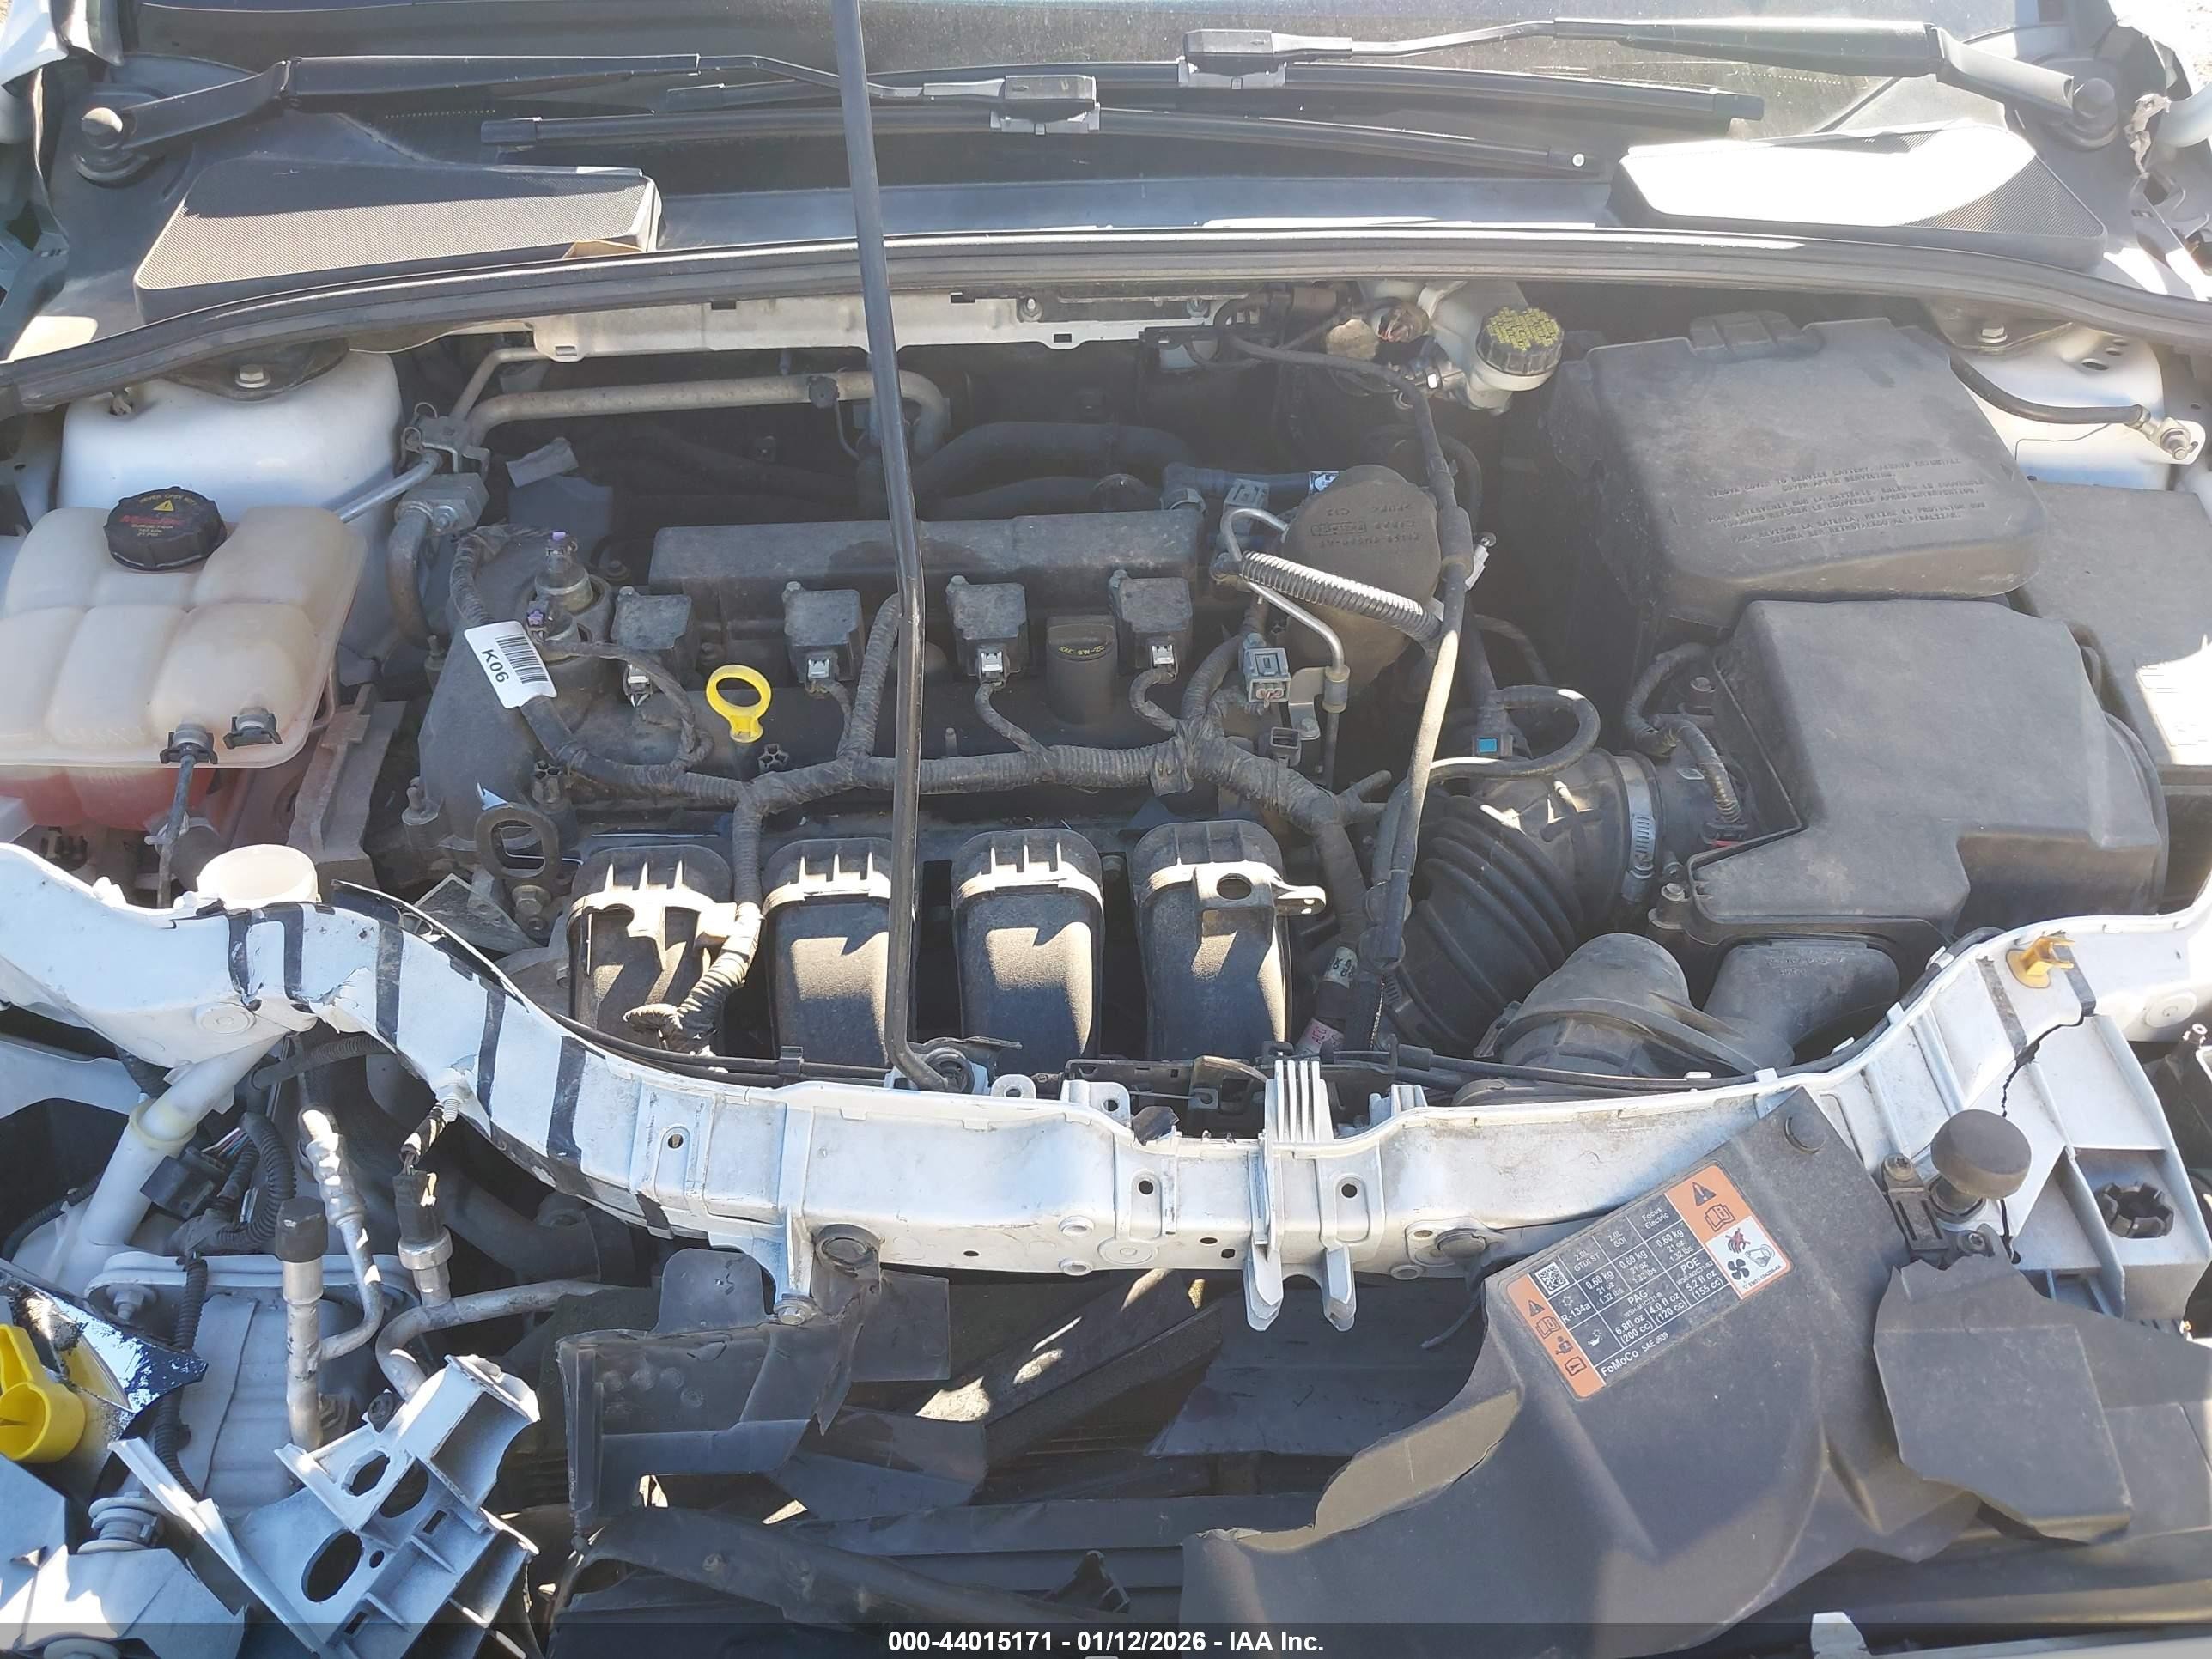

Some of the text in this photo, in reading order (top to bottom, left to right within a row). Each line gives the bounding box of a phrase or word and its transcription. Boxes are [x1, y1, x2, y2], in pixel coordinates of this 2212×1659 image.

[1059, 645, 1105, 655] SAE 5W-20
[481, 649, 509, 683] K06
[1641, 1207, 1662, 1221] Focus
[1644, 1212, 1670, 1230] Electric
[1607, 1230, 1623, 1243] 2.0L
[1613, 1237, 1628, 1248] GDI
[1656, 1228, 1685, 1249] 0.60 kg
[1667, 1243, 1677, 1253] 21
[1669, 1246, 1694, 1264] 1.32 lbs
[1591, 1253, 1601, 1263] ST
[1619, 1249, 1648, 1269] 0.60 kg
[1681, 1257, 1701, 1274] POE
[1630, 1265, 1640, 1274] 21
[1632, 1267, 1657, 1284] 1.32 lbs
[1585, 1270, 1614, 1290] 0.60 kg
[1685, 1278, 1698, 1291] 5.2
[1706, 1271, 1717, 1280] oz
[1596, 1285, 1607, 1296] 21
[1599, 1288, 1625, 1305] 1.32 lbs
[1628, 1289, 1649, 1306] PAG
[1692, 1278, 1724, 1301] (155 cc)
[1650, 1301, 1662, 1315] 4.0
[1670, 1293, 1680, 1303] oz
[1655, 1300, 1688, 1325] (120 cc)
[1561, 1303, 1590, 1324] R-134a
[1634, 1314, 1645, 1324] oz
[1621, 1322, 1654, 1346] (200 cc)
[1600, 1350, 1639, 1377] FoMoCo
[1641, 1340, 1656, 1353] SAE
